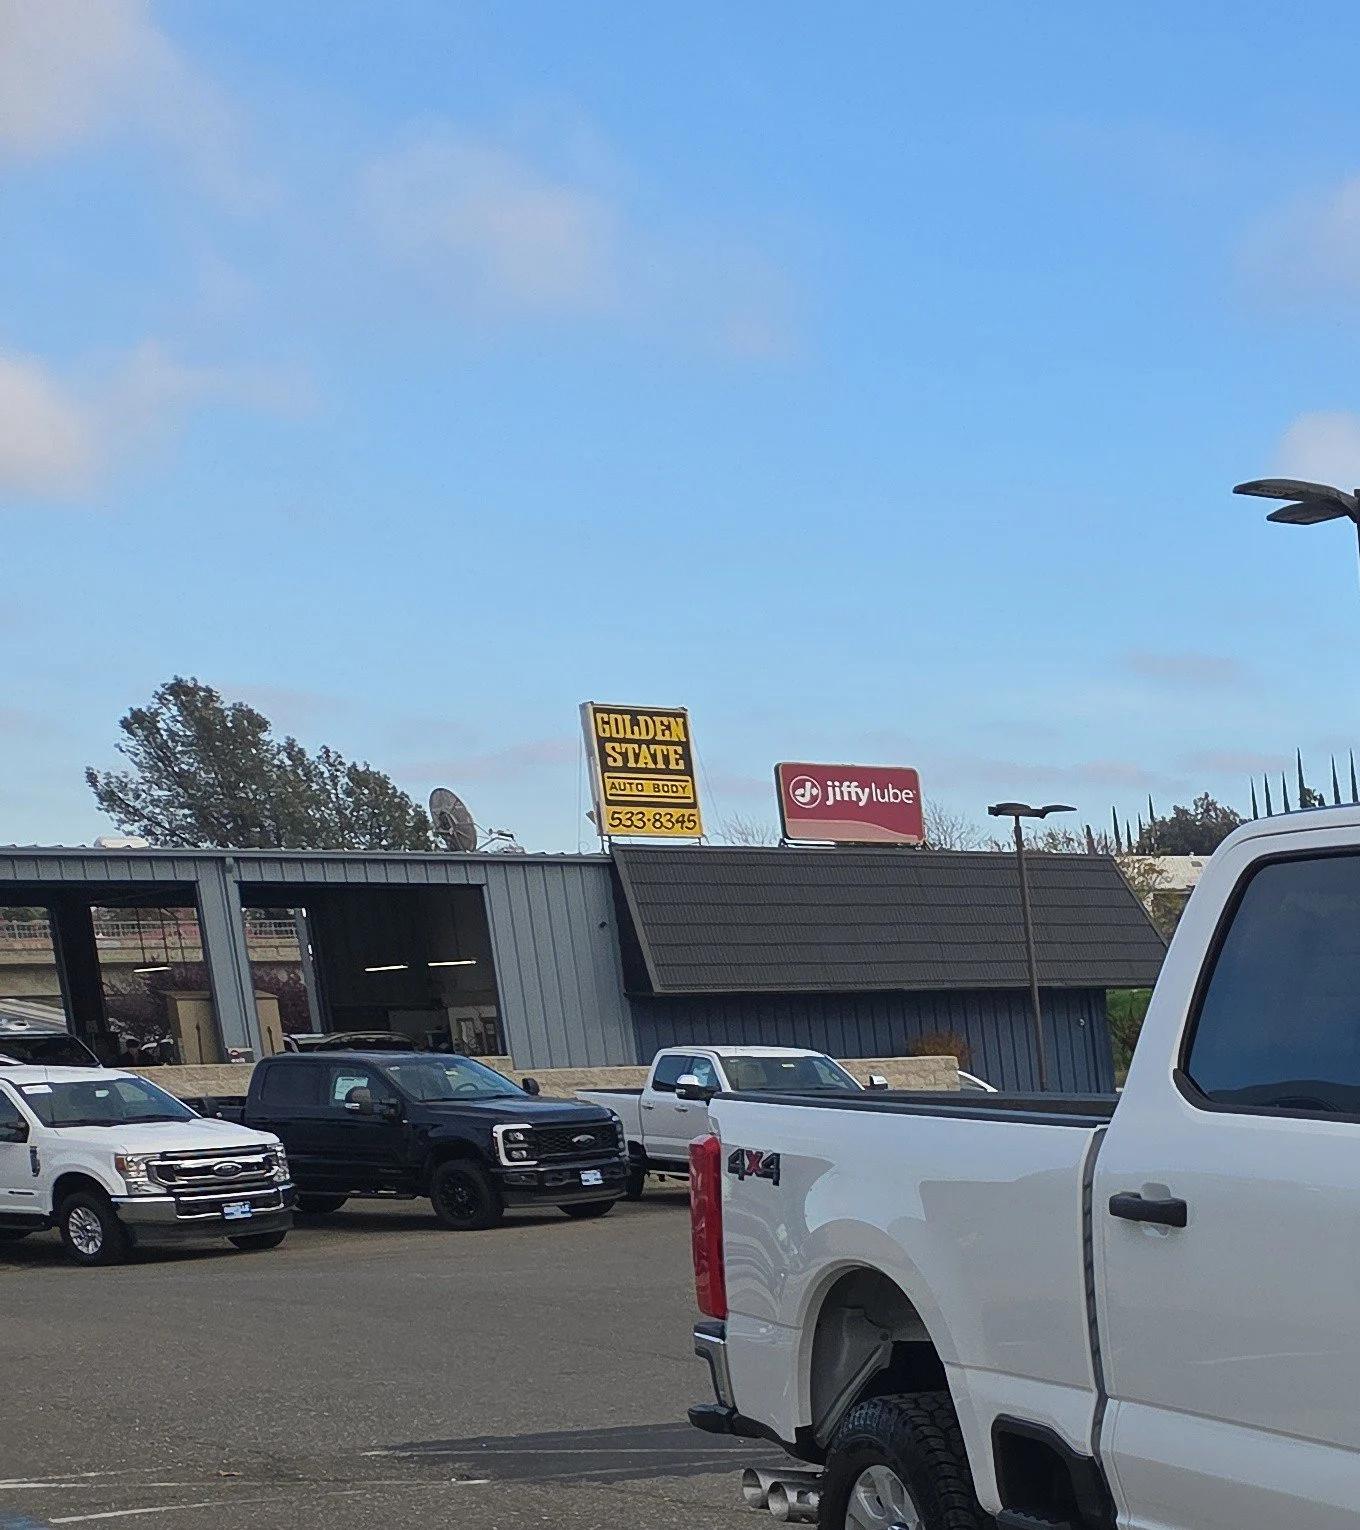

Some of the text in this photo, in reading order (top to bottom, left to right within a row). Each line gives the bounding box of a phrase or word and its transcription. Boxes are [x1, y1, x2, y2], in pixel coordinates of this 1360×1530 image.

[596, 712, 687, 742] GOLDEN
[604, 742, 685, 770] STATE
[609, 782, 688, 794] AUTO BODY
[825, 780, 914, 807] jiffy lube
